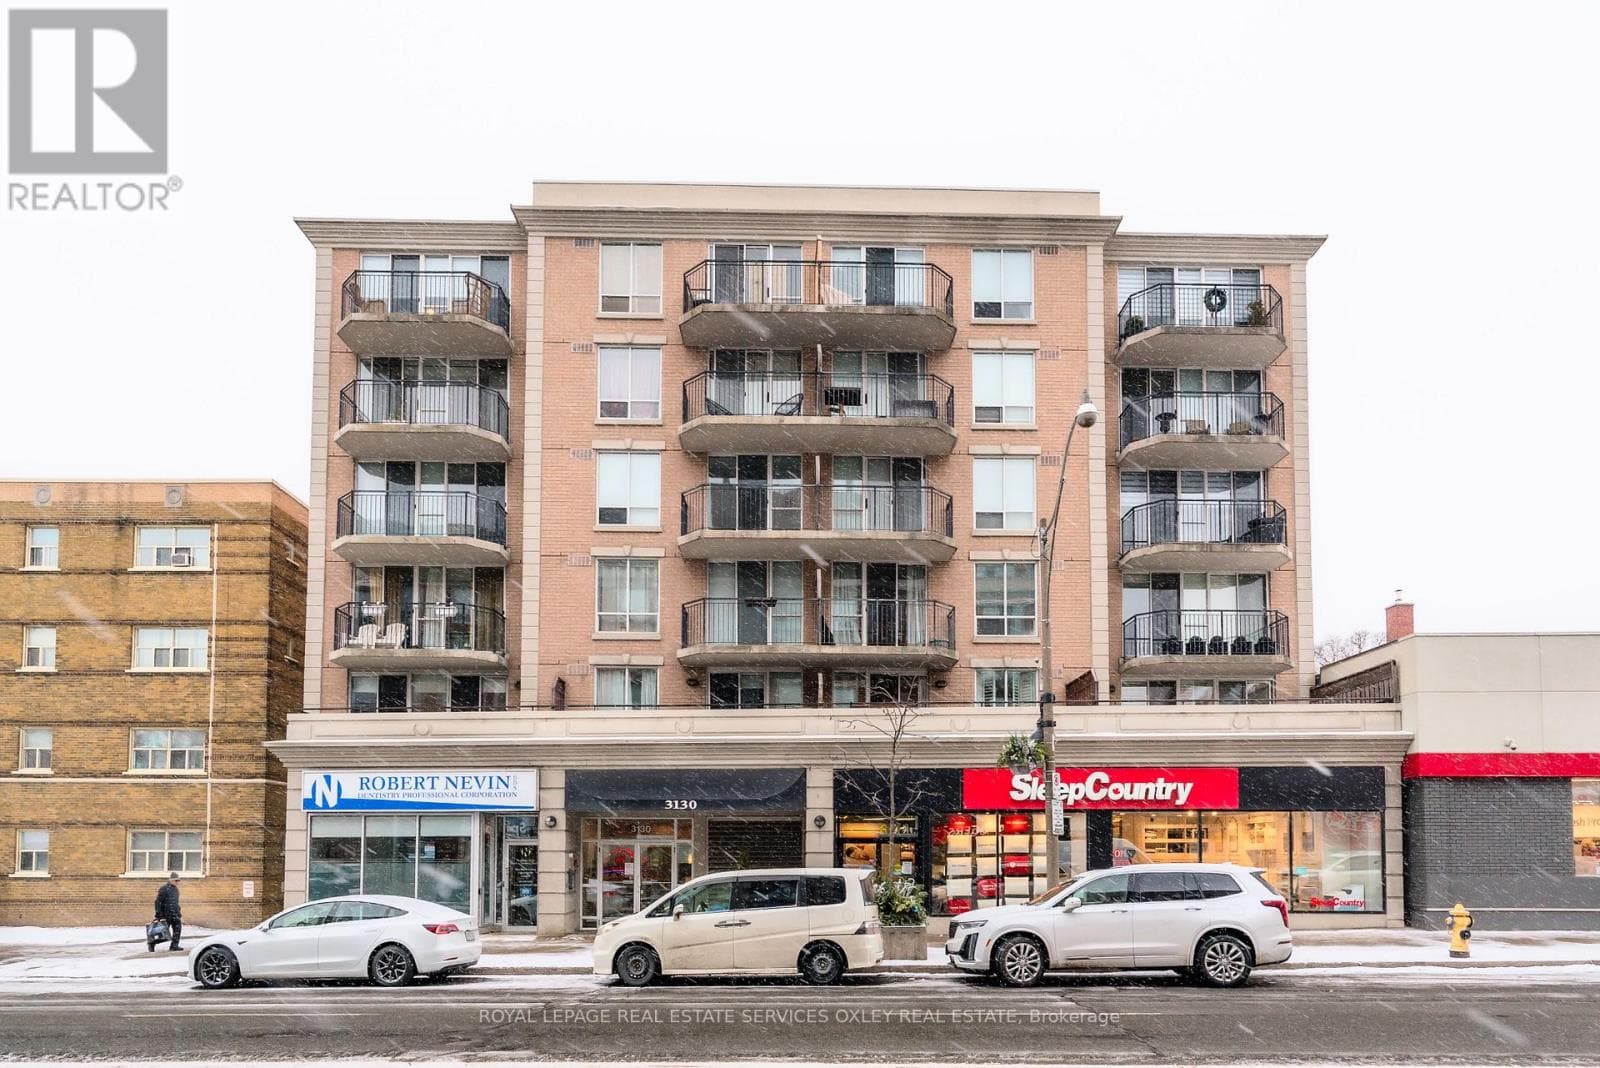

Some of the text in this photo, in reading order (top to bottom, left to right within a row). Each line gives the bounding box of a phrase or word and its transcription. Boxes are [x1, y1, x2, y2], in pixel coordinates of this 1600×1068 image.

[358, 775, 440, 791] ROBERT
[444, 775, 511, 790] NEVIN
[357, 791, 518, 799] DENTISTRY PROFESSIONAL CORPORATION
[664, 799, 698, 810] 3130
[631, 824, 651, 833] 3130
